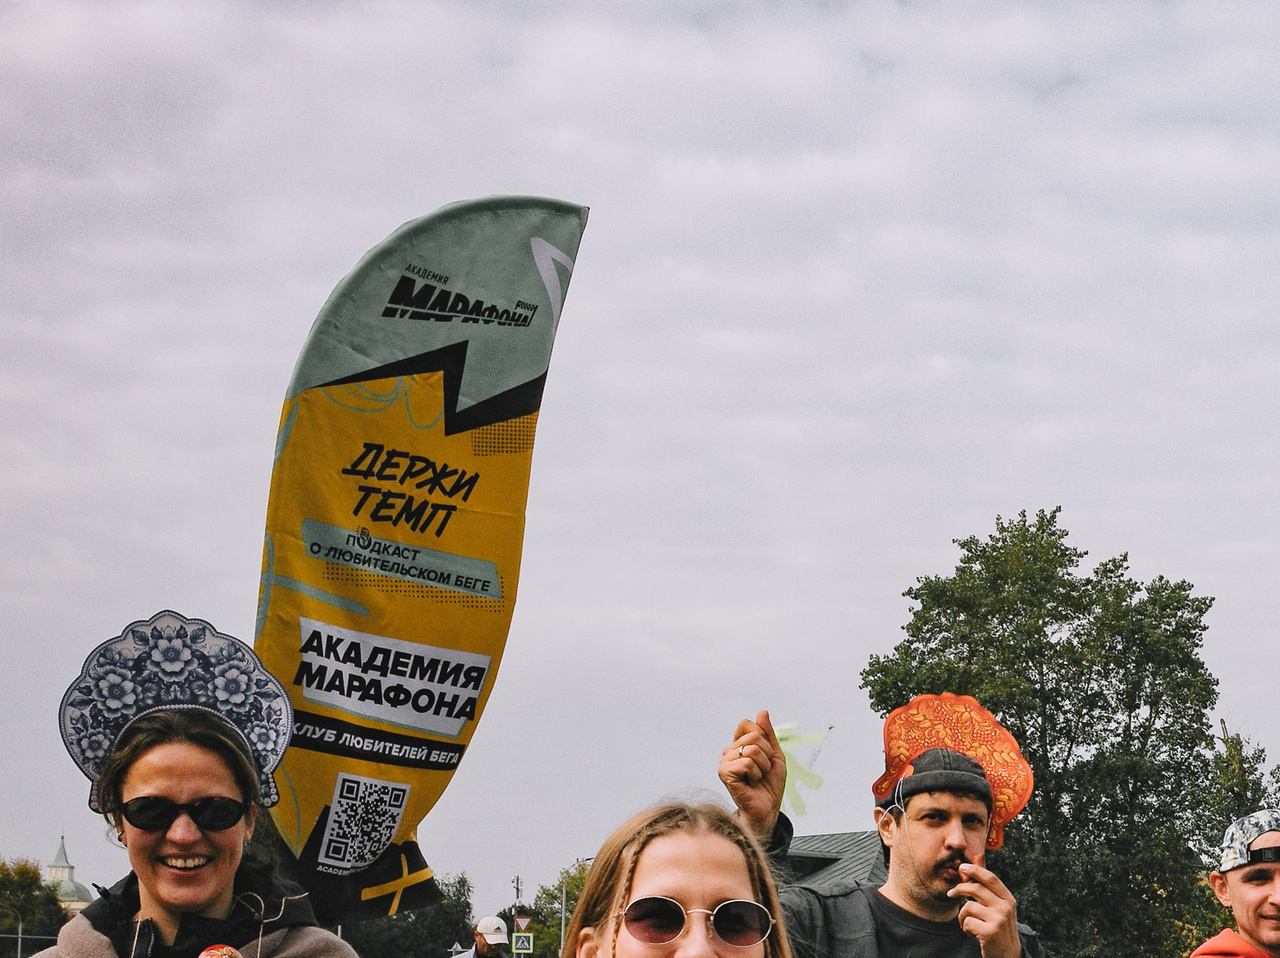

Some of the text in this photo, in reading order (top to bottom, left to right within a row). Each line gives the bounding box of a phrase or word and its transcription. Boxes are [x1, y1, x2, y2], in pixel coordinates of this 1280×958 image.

[405, 263, 449, 285] АКАДЕМИЯ
[381, 275, 538, 327] МАРАФОНА
[341, 442, 480, 503] ДЕРЖИ
[352, 485, 457, 538] ТЕМП
[309, 542, 491, 592] О ЛЮБИТЕЛЬСКОМ БЕГЕ
[345, 529, 420, 561] ПОДКАСТ
[299, 629, 487, 691] АКАДЕМИЯ
[292, 660, 478, 721] МАРАФОНА
[338, 732, 428, 760] ЛЮБИТЕЛЕЙ
[429, 750, 460, 764] БЕГА
